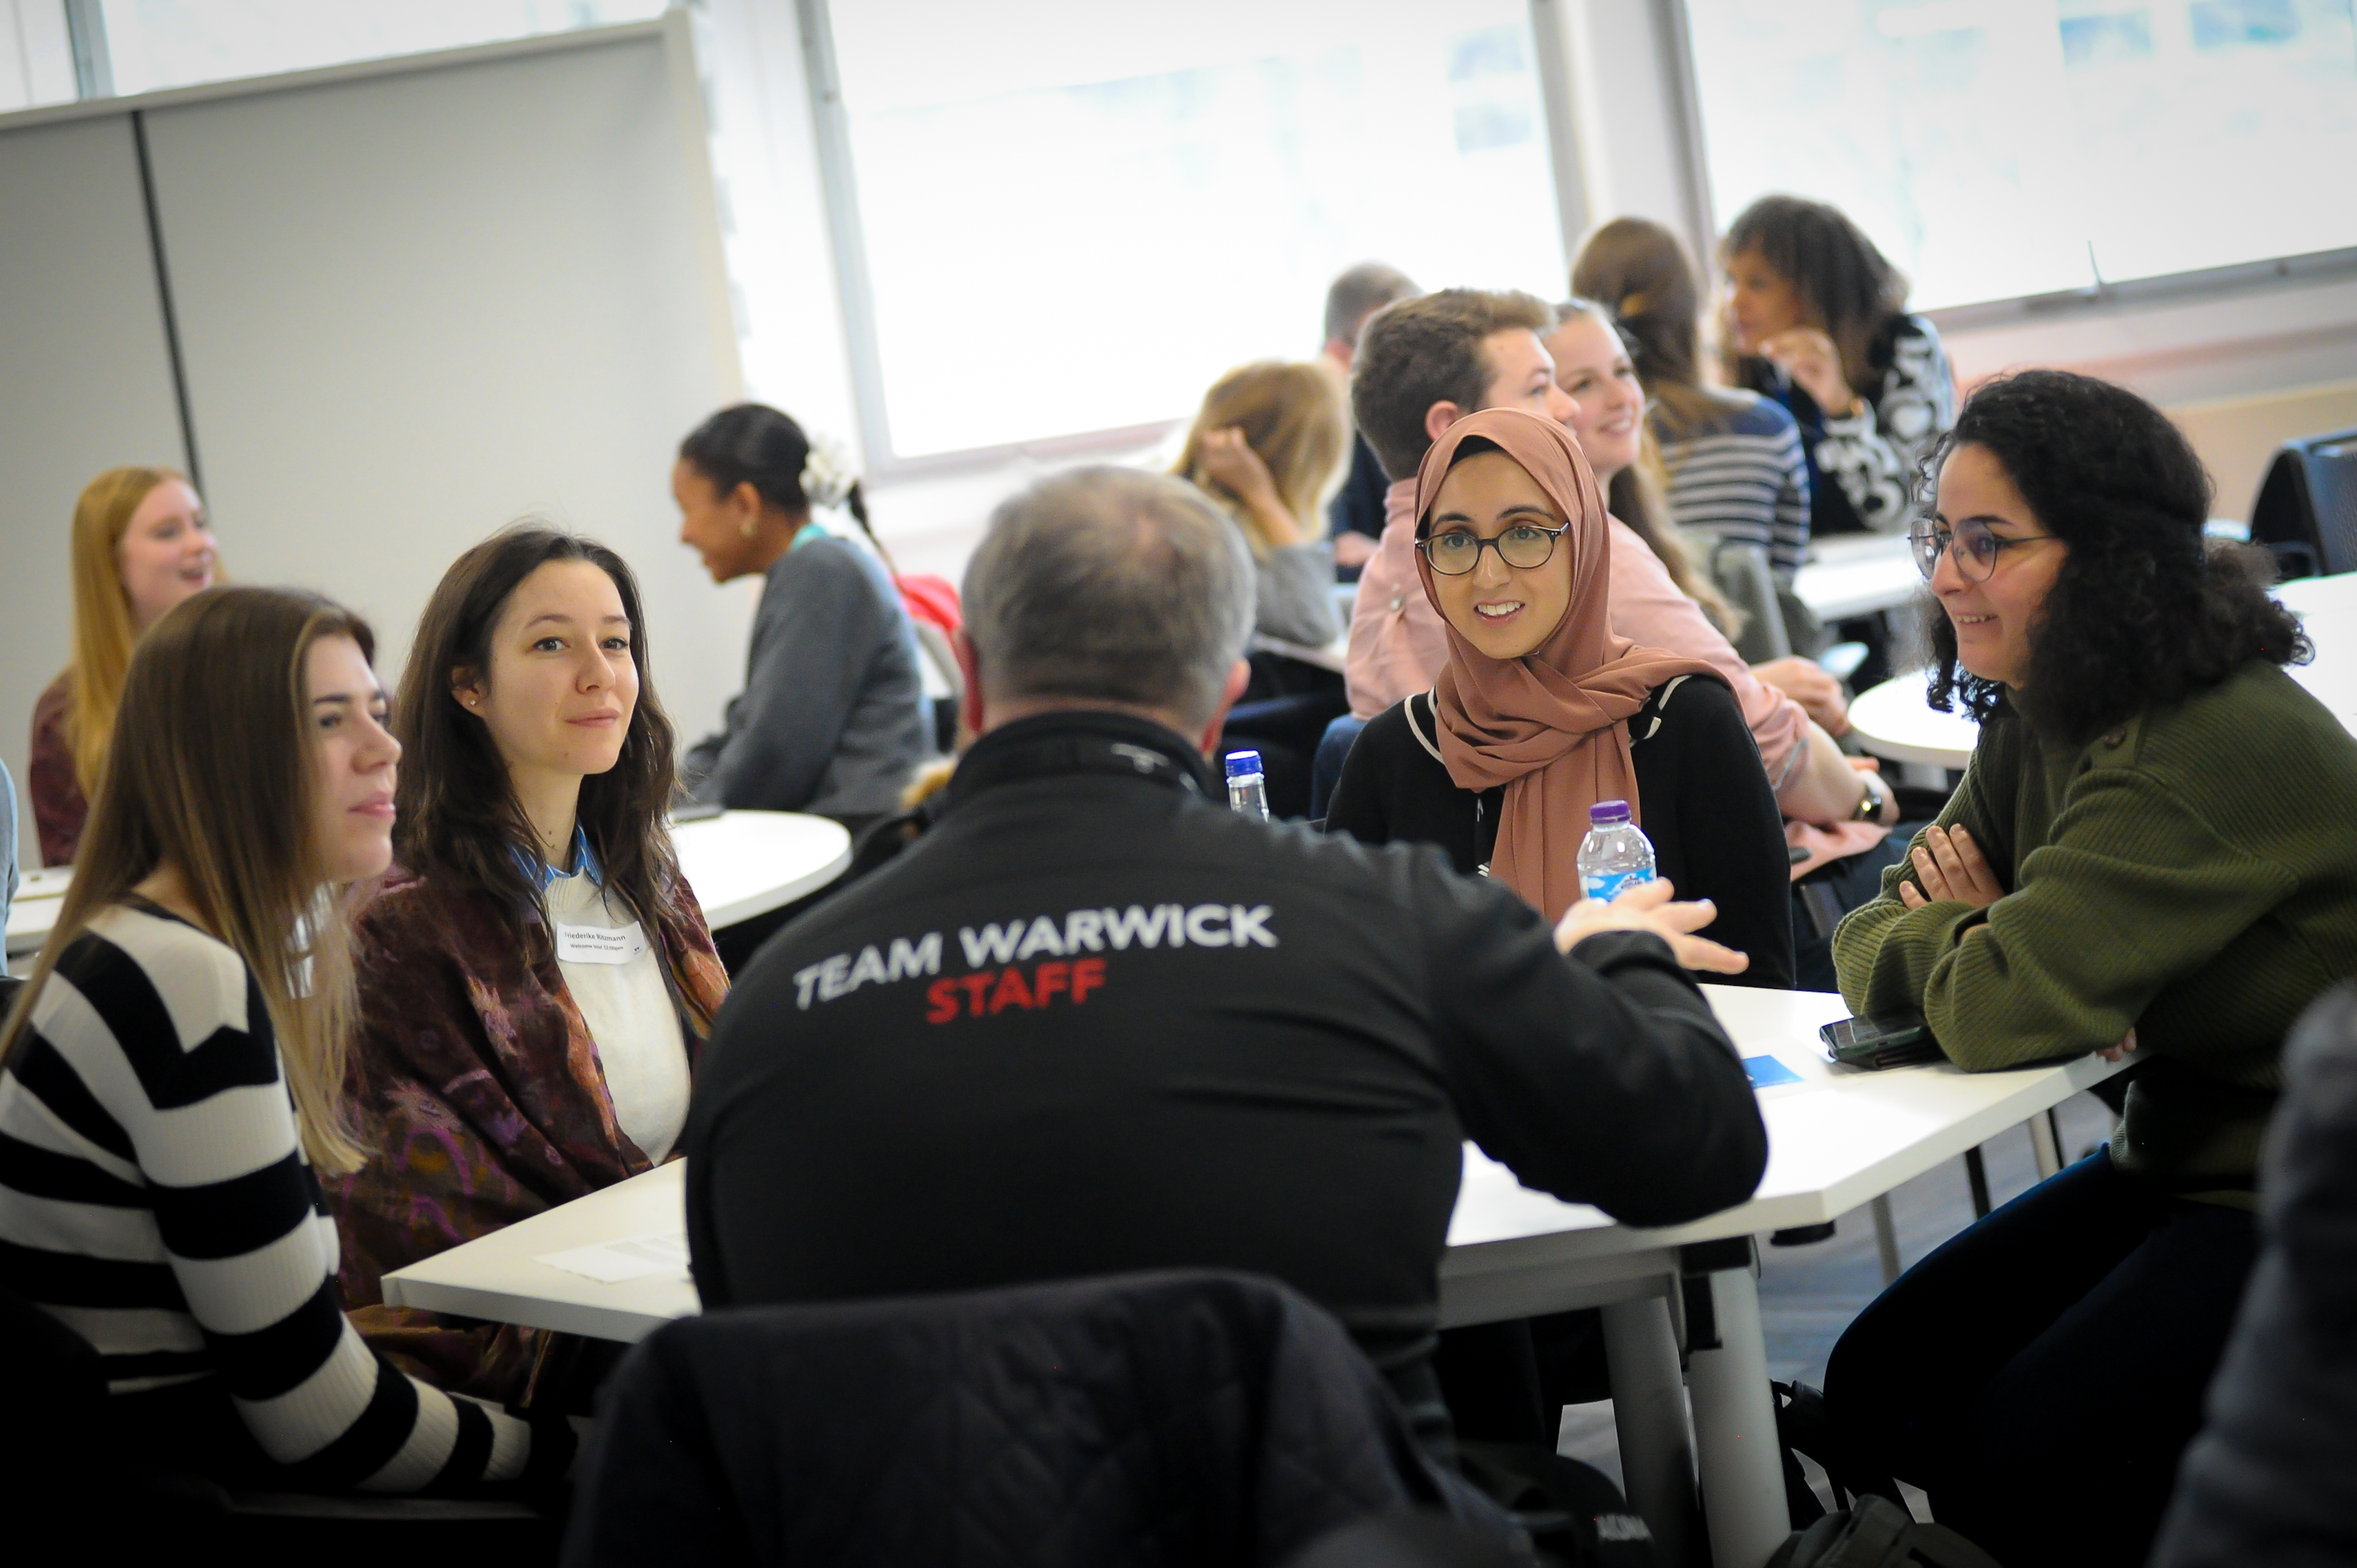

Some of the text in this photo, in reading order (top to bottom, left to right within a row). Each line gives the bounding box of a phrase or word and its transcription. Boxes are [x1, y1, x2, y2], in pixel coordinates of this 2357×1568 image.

[794, 904, 1278, 1010] TEAM WARWICK
[926, 957, 1108, 1024] STAFF
